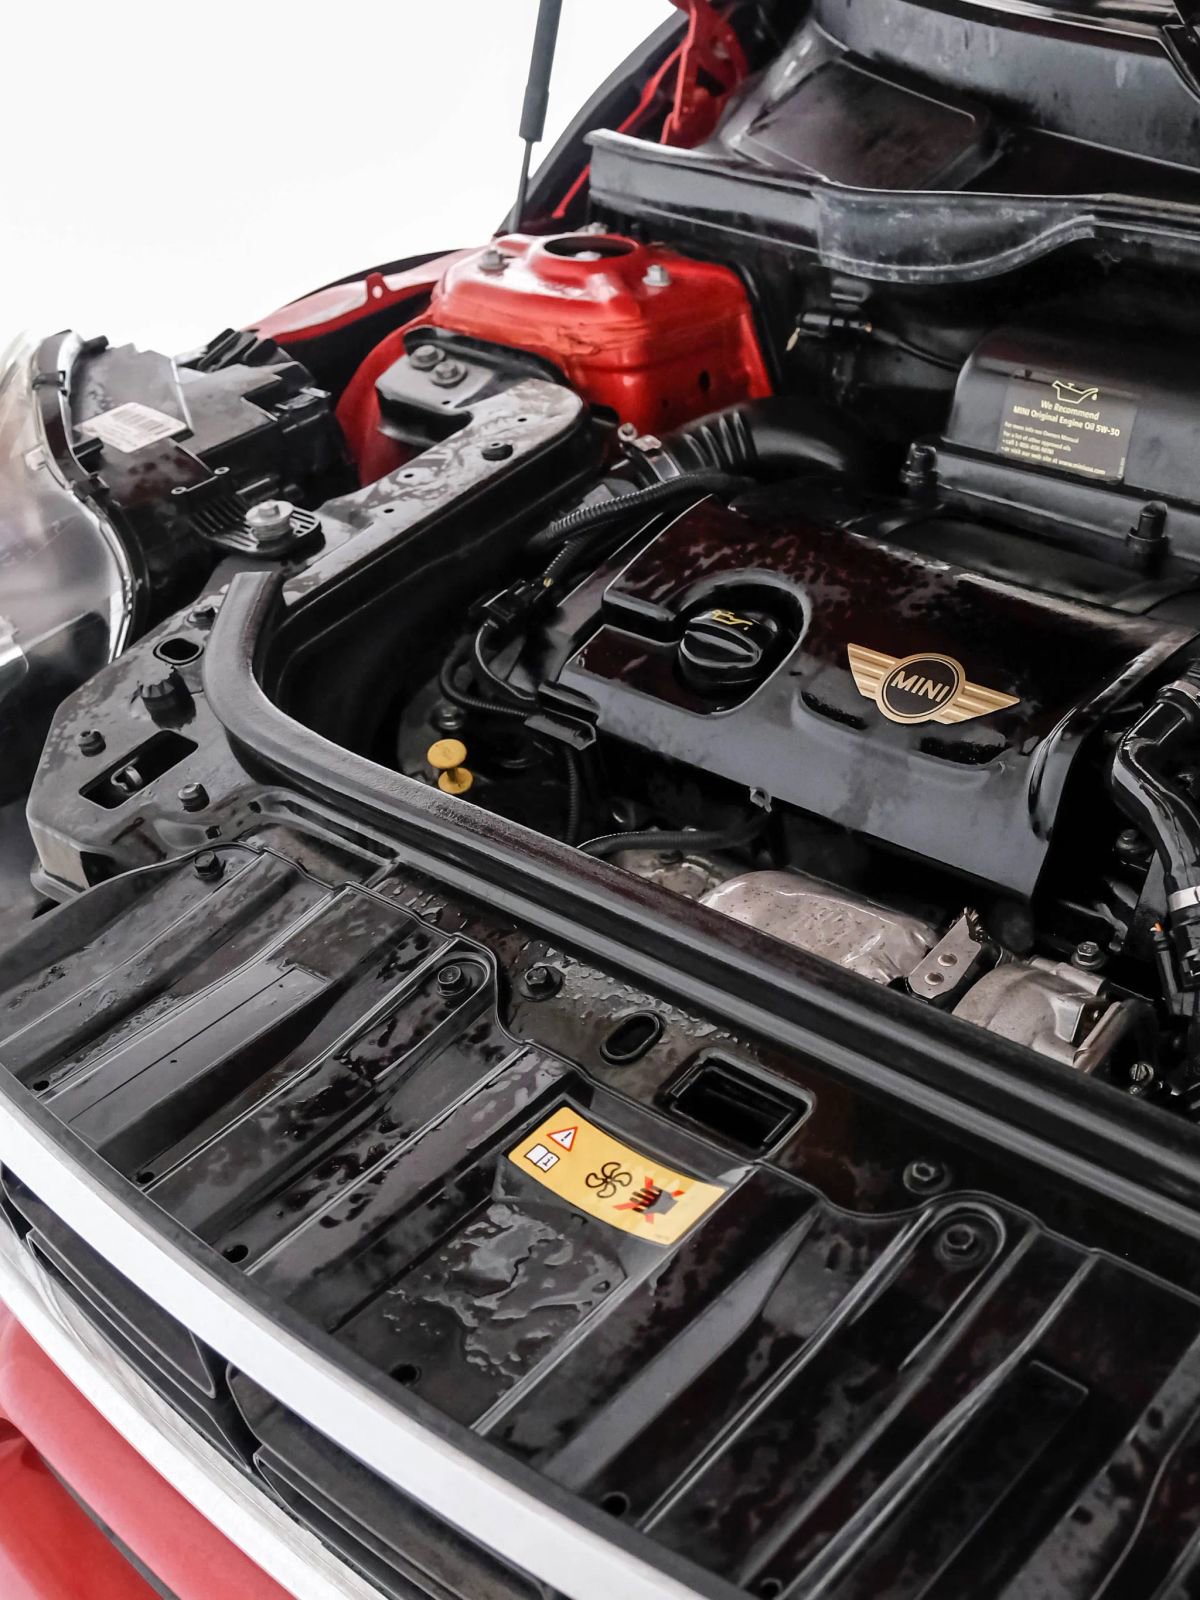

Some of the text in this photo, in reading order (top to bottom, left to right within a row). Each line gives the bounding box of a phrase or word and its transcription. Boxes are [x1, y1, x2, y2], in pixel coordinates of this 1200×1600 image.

[1013, 405, 1120, 437] MINI Original Engine Oil 5W-30
[1054, 403, 1100, 420] Recommend
[891, 670, 950, 703] MINI
